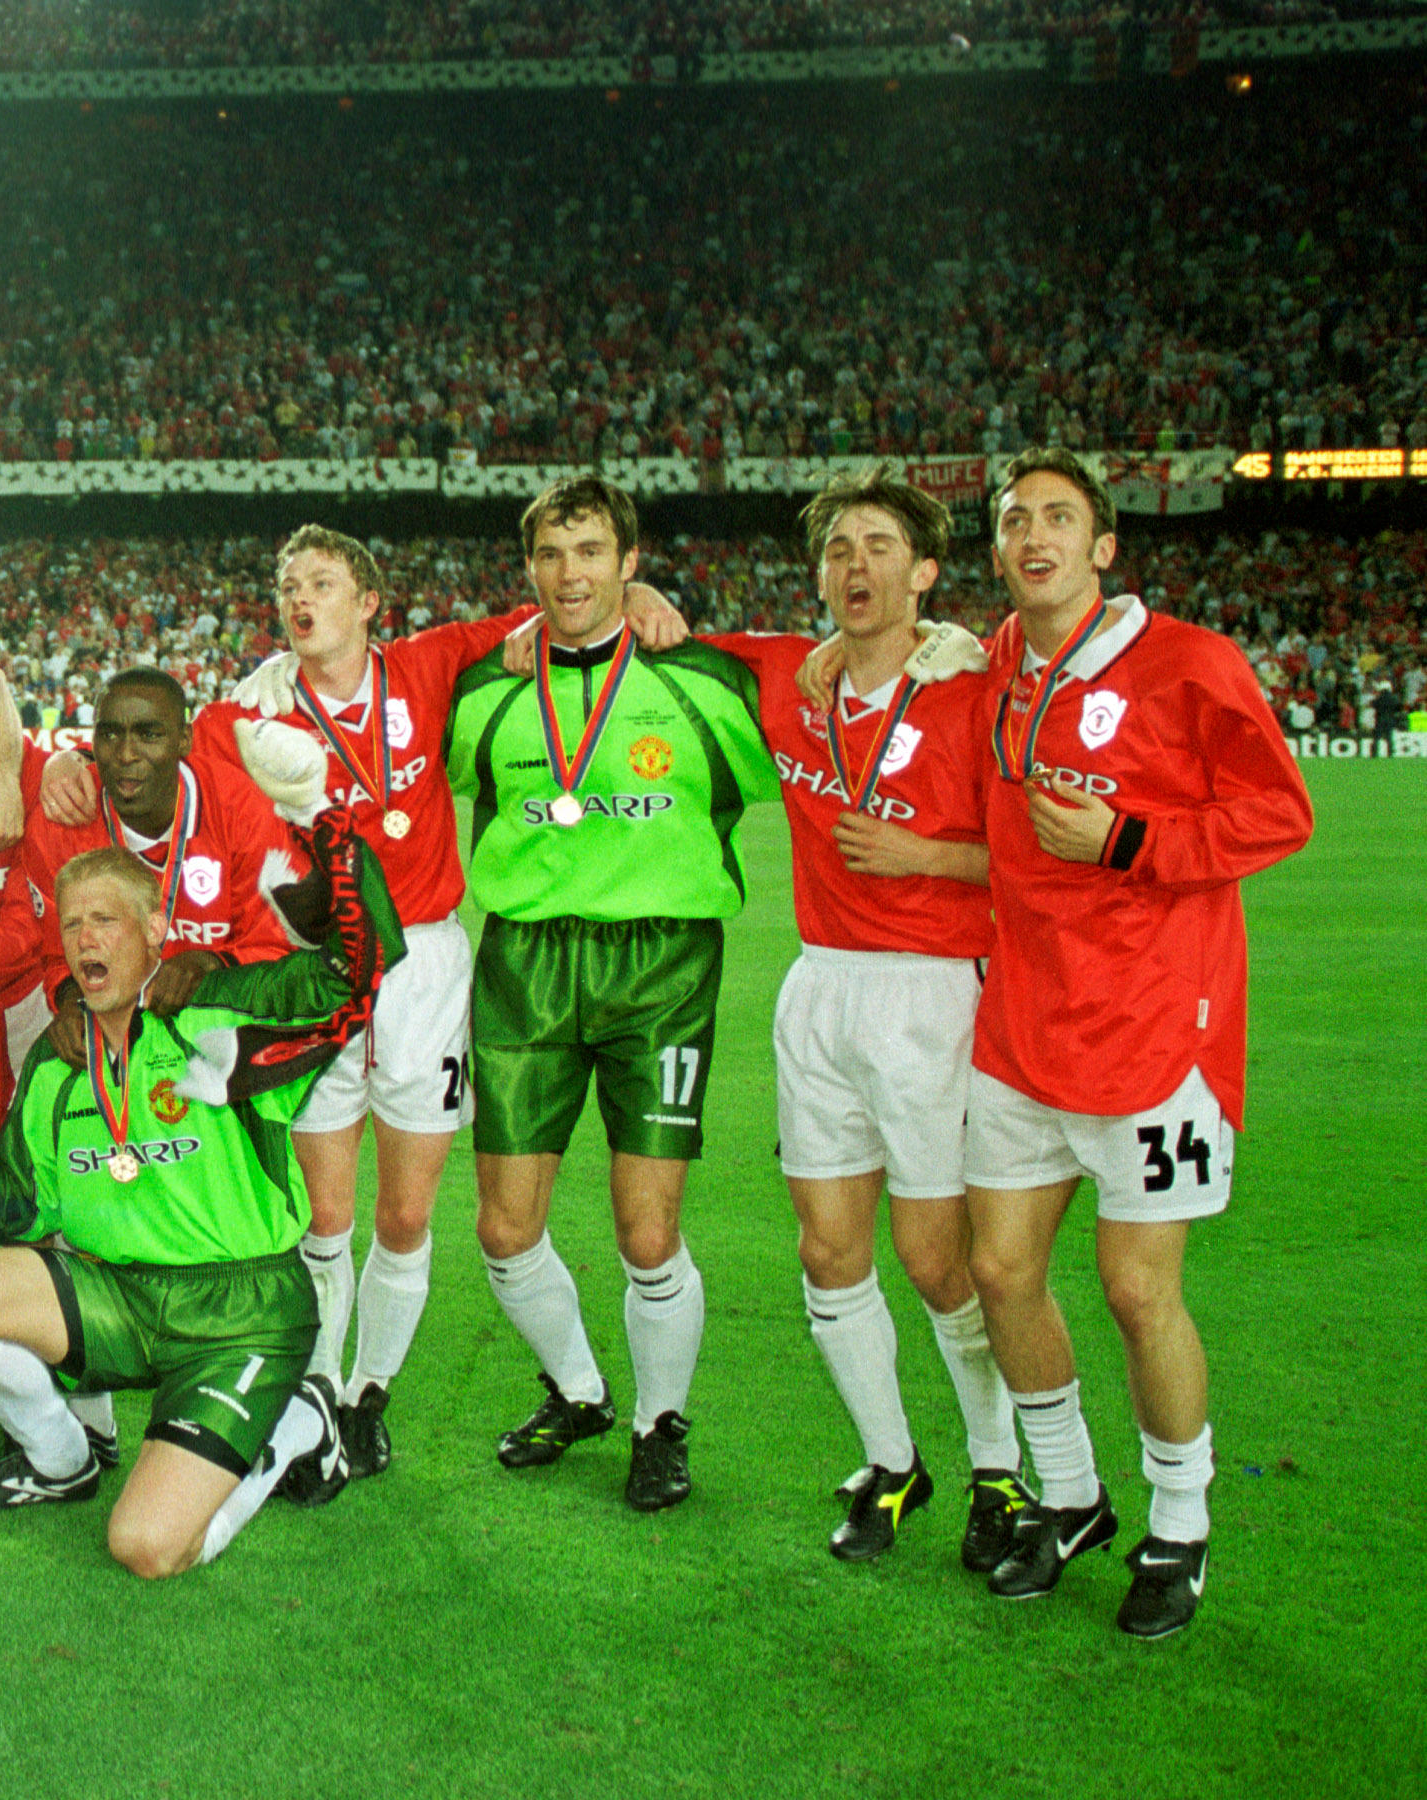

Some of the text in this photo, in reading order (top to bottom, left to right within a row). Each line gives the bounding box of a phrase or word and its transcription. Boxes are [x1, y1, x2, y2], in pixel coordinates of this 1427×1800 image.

[914, 463, 981, 485] MUFC
[1233, 452, 1272, 478] 45
[22, 727, 95, 752] MST
[1284, 731, 1389, 759] tion
[774, 751, 916, 821] SHARP
[1032, 761, 1118, 795] ARP
[165, 918, 231, 945] ARP
[658, 1045, 700, 1106] 17
[67, 1138, 201, 1175] SHARP
[1136, 1119, 1211, 1193] 34
[234, 1353, 265, 1395] 1
